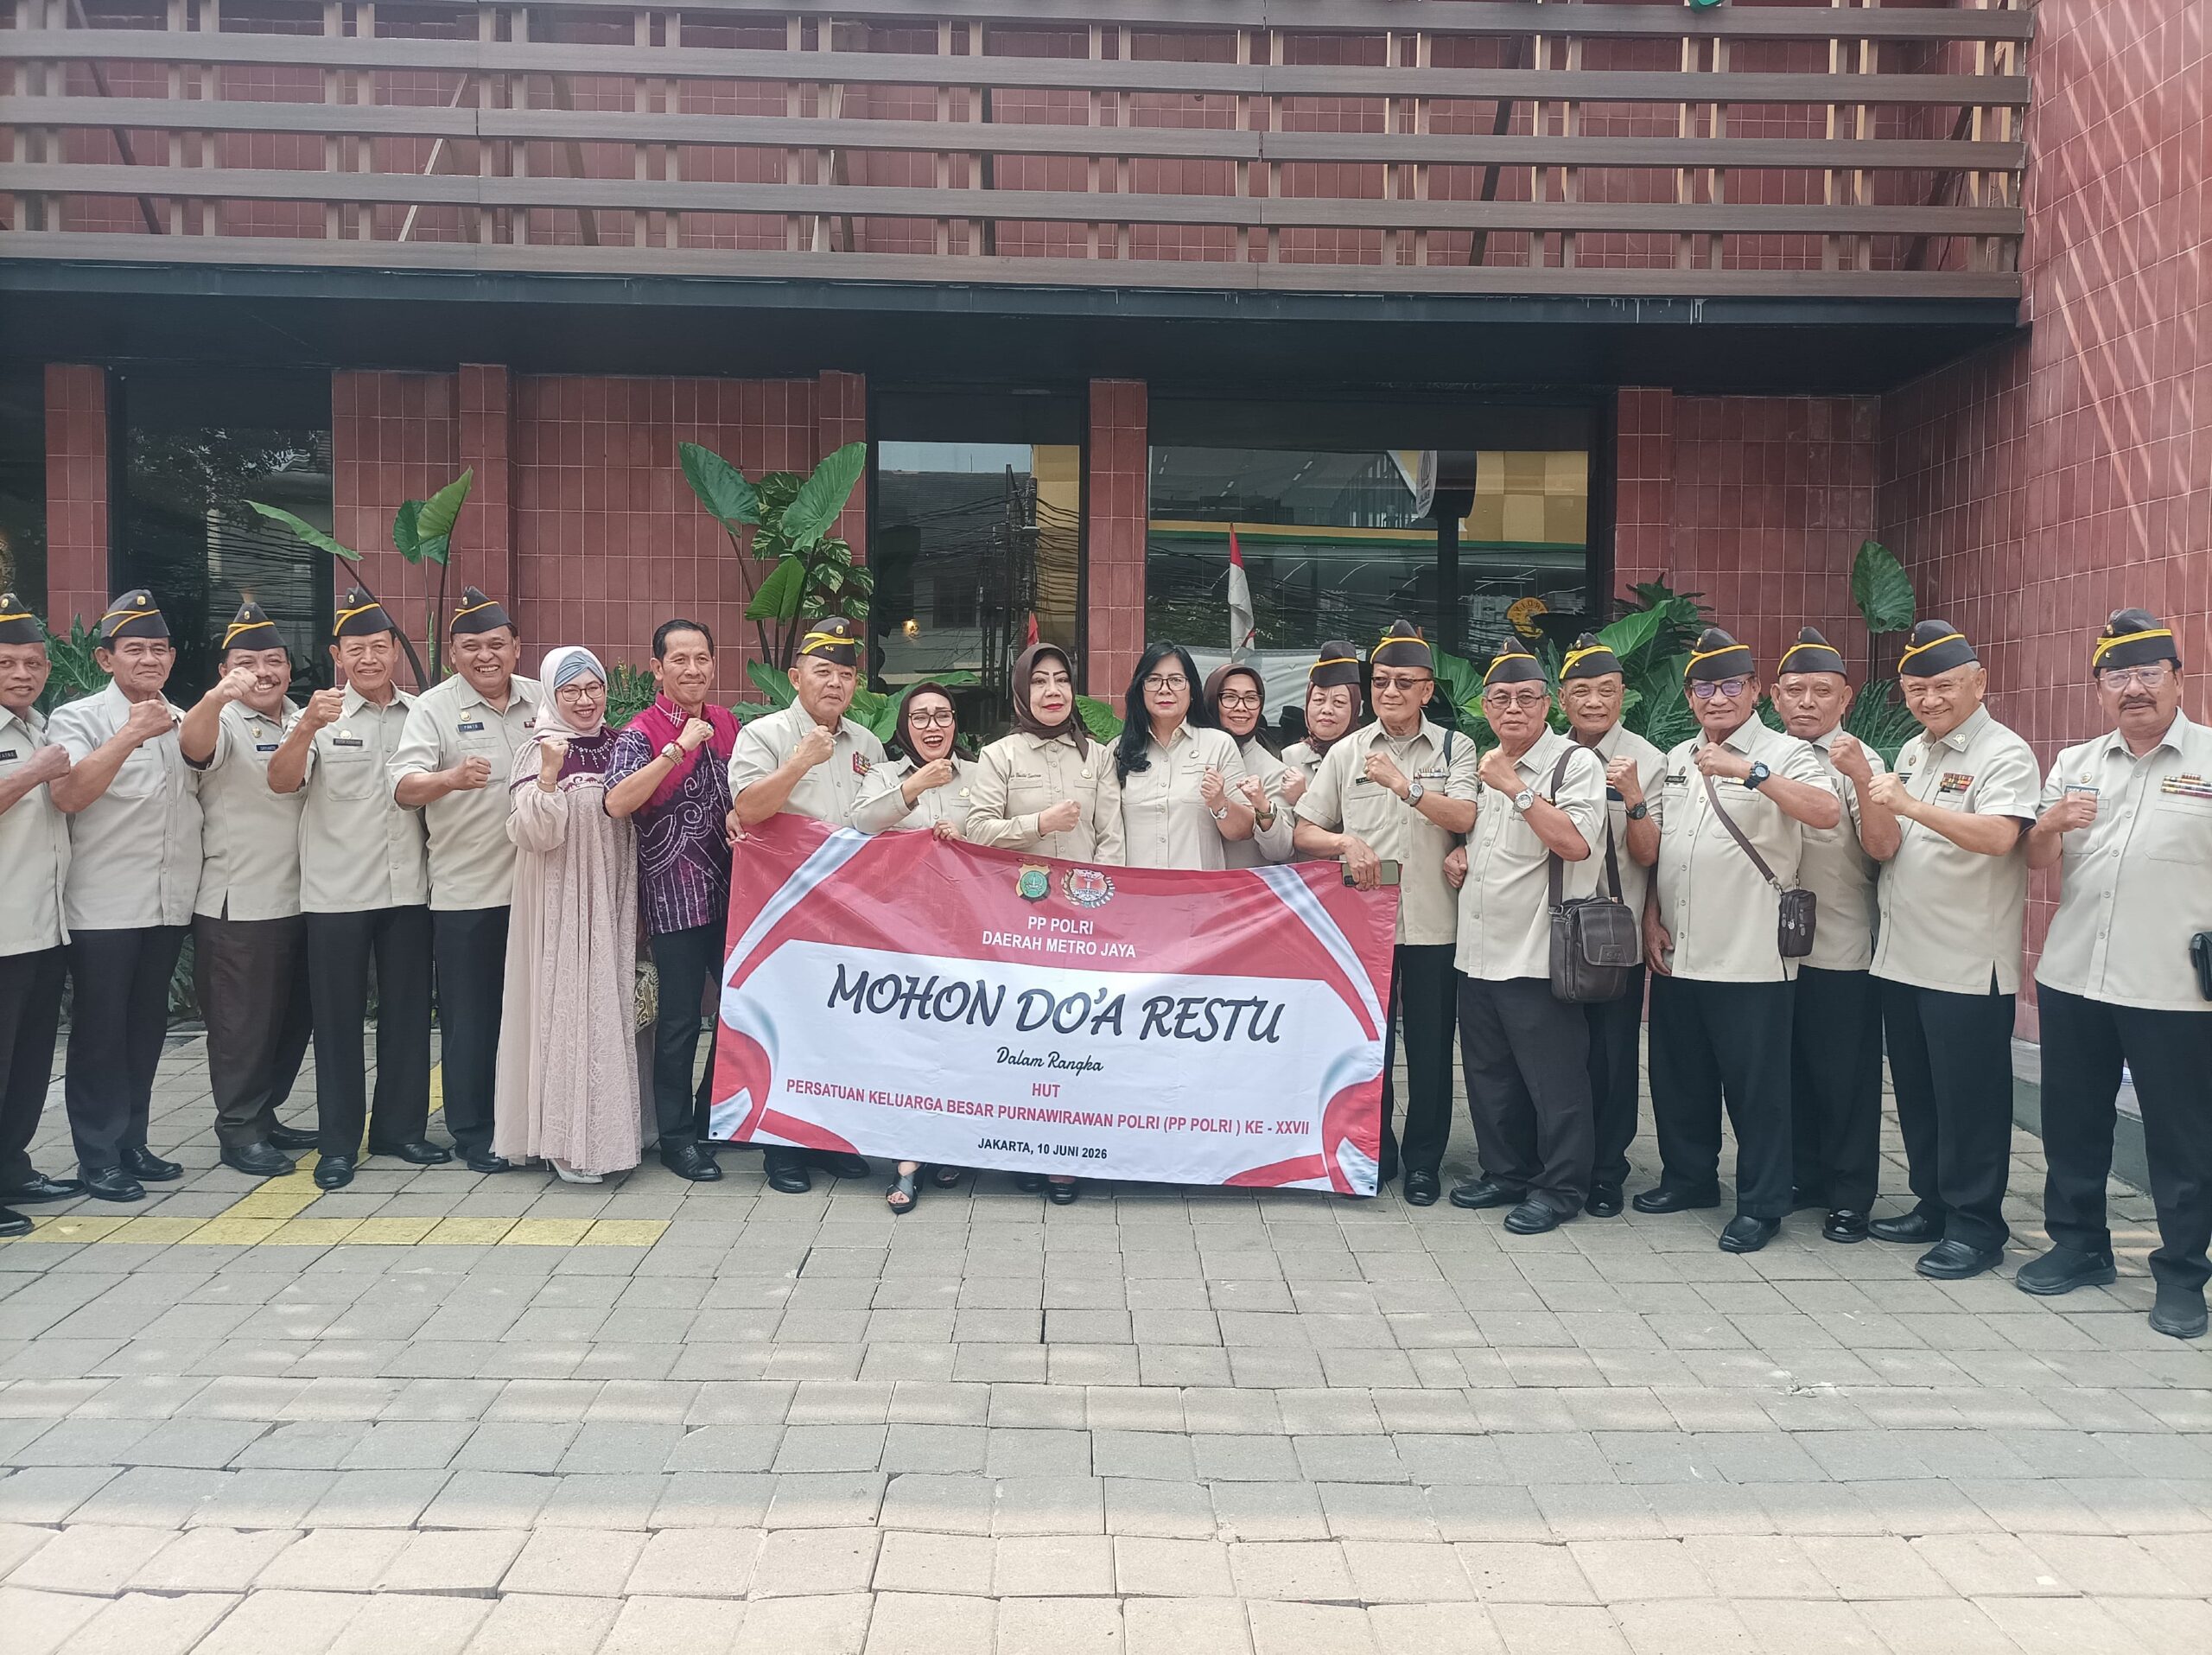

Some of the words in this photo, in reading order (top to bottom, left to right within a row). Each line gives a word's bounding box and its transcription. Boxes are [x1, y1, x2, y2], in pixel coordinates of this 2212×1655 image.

[1027, 916, 1047, 931] PP
[1050, 918, 1094, 935] POLRI
[982, 930, 1042, 951] DAERAH
[1046, 938, 1097, 956] METRO
[1100, 943, 1136, 958] JAYA
[827, 963, 1007, 1028] MOHON
[1015, 987, 1127, 1036] DO'A
[1139, 996, 1286, 1044] RESTU
[996, 1047, 1045, 1067] Dalam
[1047, 1051, 1104, 1077] Rangka
[1032, 1083, 1061, 1098] HUT
[786, 1079, 865, 1102] PERSATUAN
[868, 1091, 944, 1112] KELUARGA
[946, 1099, 994, 1117] BESAR
[997, 1105, 1114, 1128] PURNAWIRAWAN
[1117, 1113, 1160, 1130] POLRI
[1163, 1116, 1186, 1133] (PP
[1190, 1117, 1232, 1134] POLRI
[1244, 1120, 1263, 1135] KE
[1274, 1121, 1310, 1135] XXVII
[977, 1138, 1034, 1155] JAKARTA,
[1037, 1143, 1050, 1155] 10
[1052, 1144, 1079, 1157] JUNI
[1082, 1147, 1108, 1159] 2026
